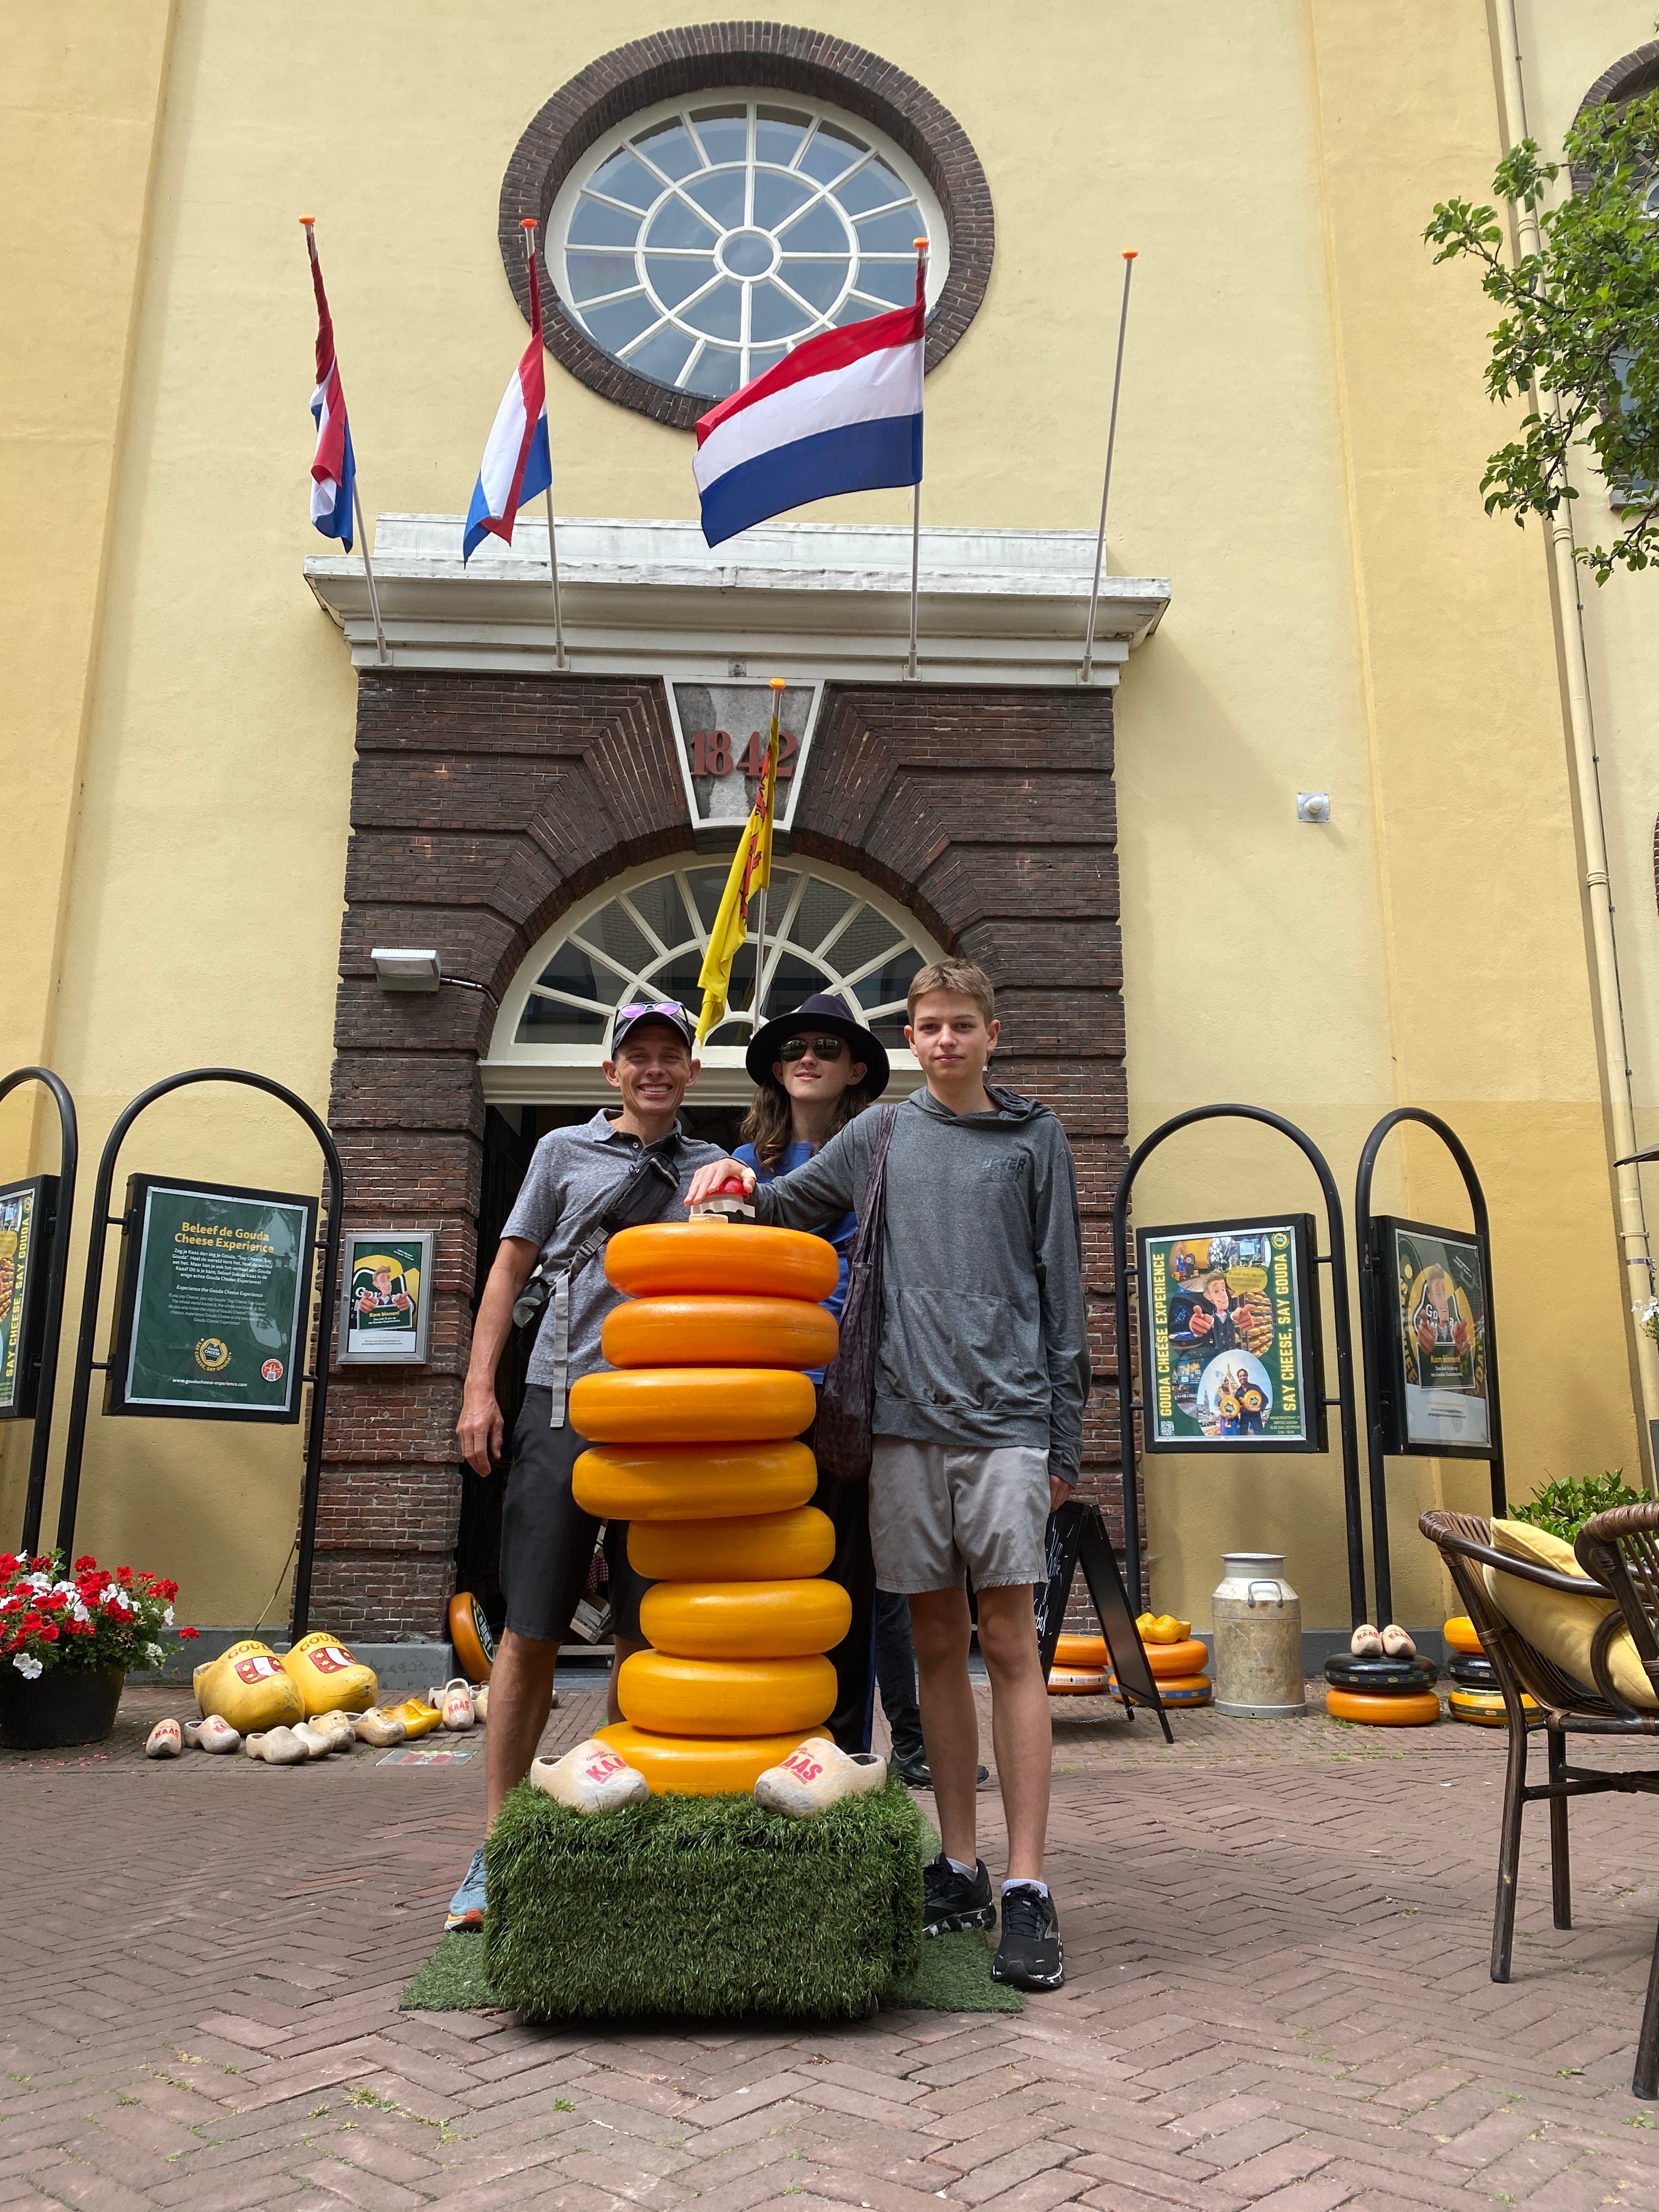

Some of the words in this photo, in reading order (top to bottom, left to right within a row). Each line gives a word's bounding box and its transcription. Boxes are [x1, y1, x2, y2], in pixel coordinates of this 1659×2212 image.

[690, 730, 798, 778] 1842
[19, 1217, 30, 1259] GOUDA
[174, 1233, 213, 1246] Cheese
[216, 1238, 274, 1253] Experience
[182, 1222, 218, 1234] Beleef
[219, 1227, 233, 1237] de
[235, 1229, 269, 1241] Gouda
[15, 1264, 25, 1288] SAY
[1274, 1254, 1289, 1295] GOUDA
[1153, 1253, 1168, 1324] EXPERIENCE
[1277, 1299, 1290, 1324] SAY
[1156, 1328, 1170, 1373] CHEESE
[1279, 1328, 1294, 1380] CHEESE,
[5, 1351, 16, 1376] SAY
[1159, 1377, 1172, 1417] GOUDA
[1283, 1385, 1297, 1411] SAY
[1357, 1631, 1379, 1641] KAAS
[448, 1700, 470, 1717] KAAS
[155, 1728, 179, 1739] KAAS
